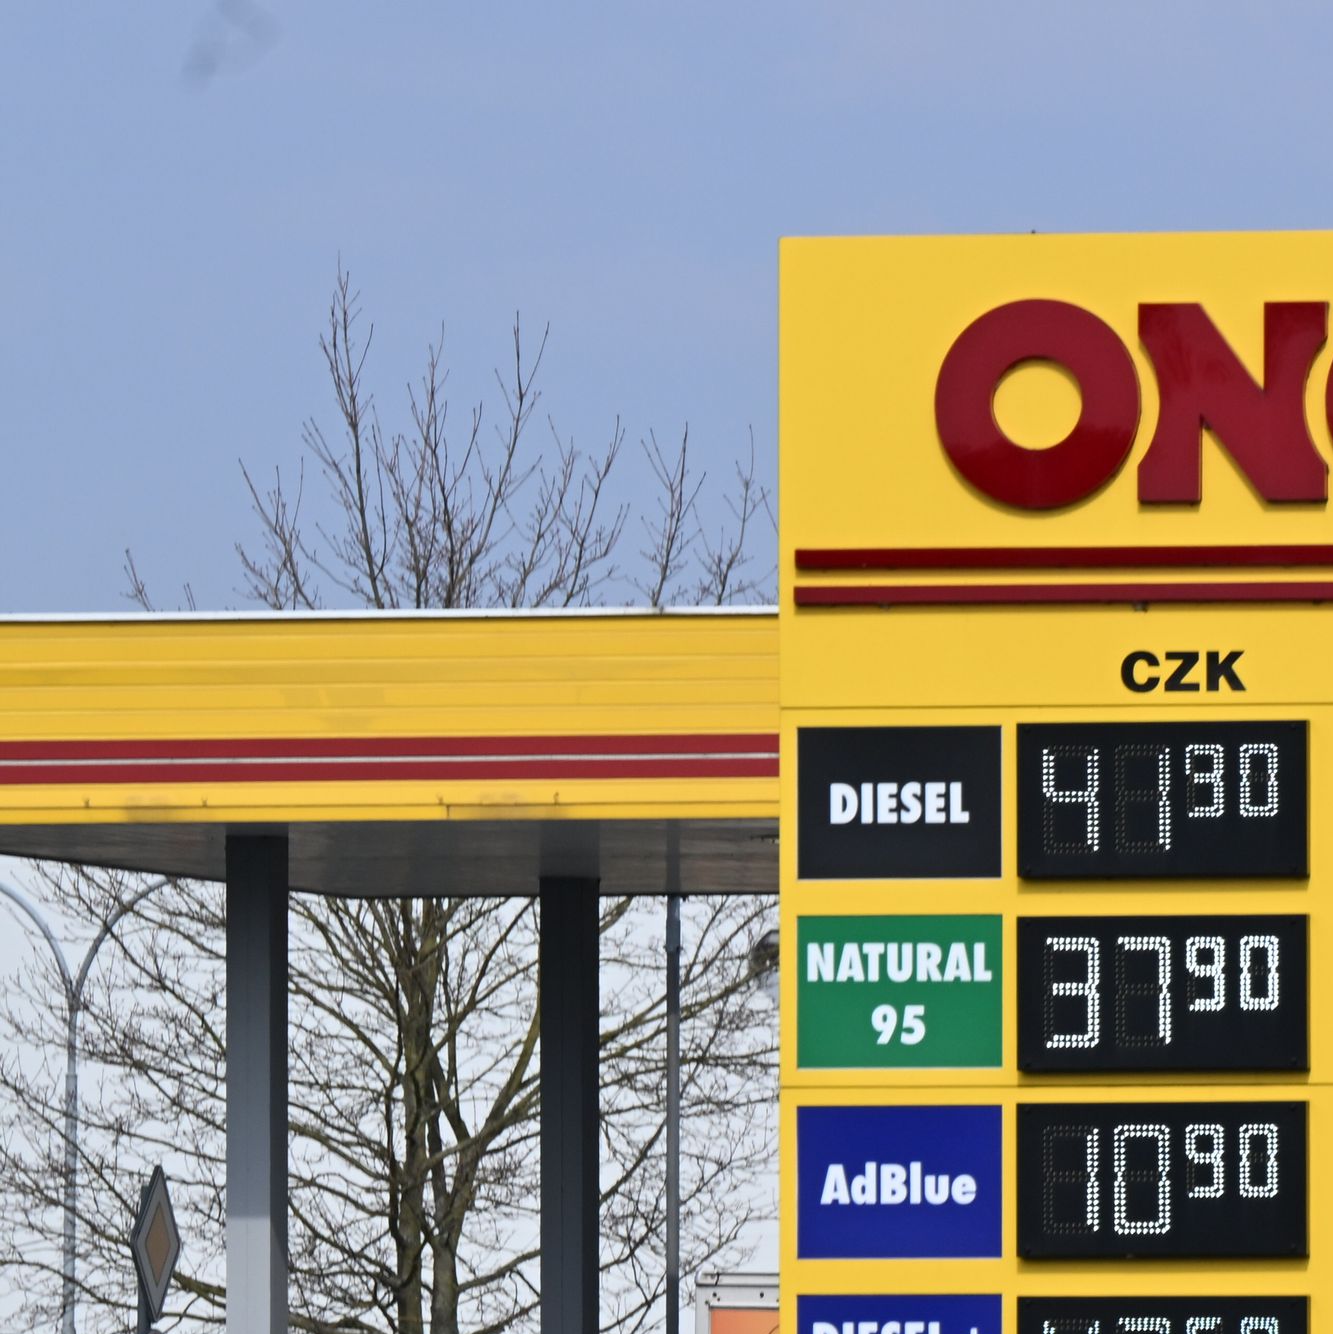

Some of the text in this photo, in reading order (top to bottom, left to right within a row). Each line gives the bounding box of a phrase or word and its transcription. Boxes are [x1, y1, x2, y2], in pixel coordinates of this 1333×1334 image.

[1120, 650, 1246, 692] CZK
[829, 780, 970, 825] DIESEL
[806, 940, 993, 984] NATURAL
[871, 1003, 927, 1046] 95
[820, 1160, 978, 1206] AdBlue
